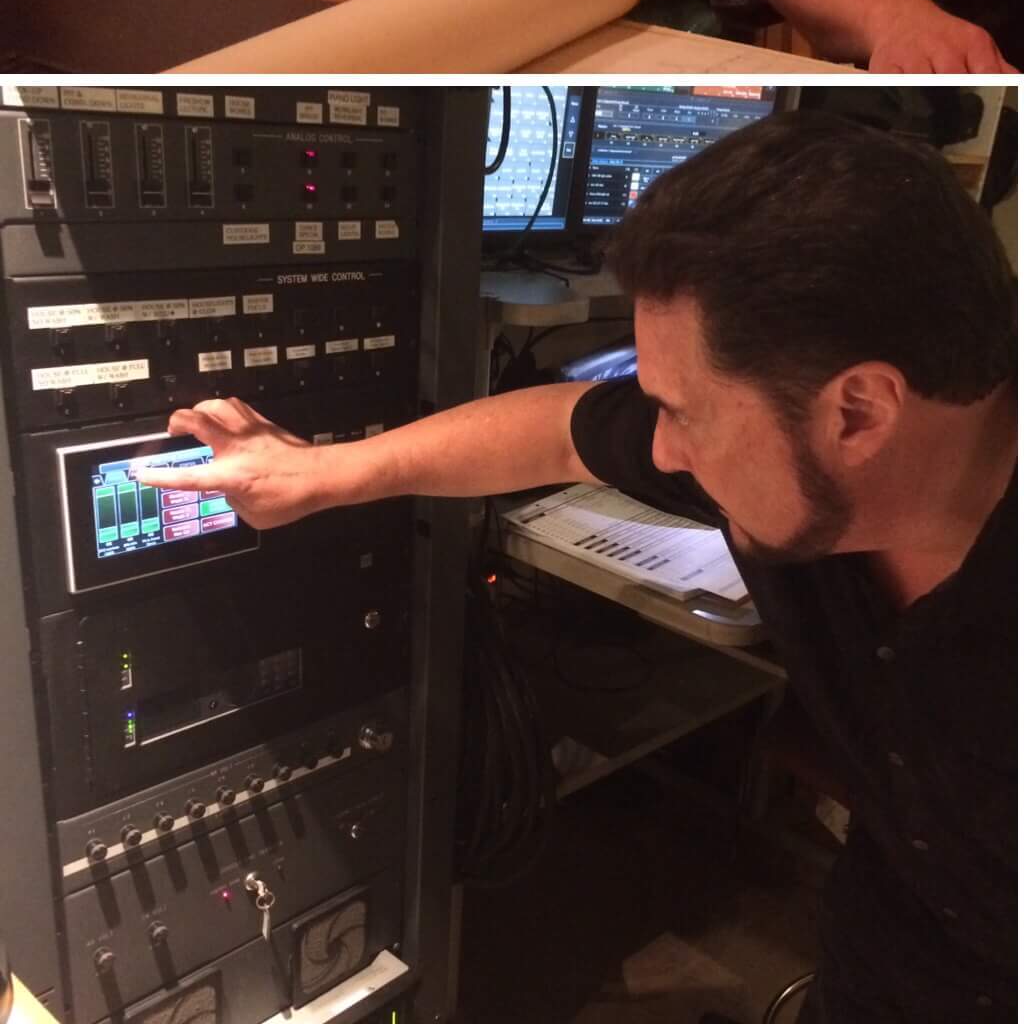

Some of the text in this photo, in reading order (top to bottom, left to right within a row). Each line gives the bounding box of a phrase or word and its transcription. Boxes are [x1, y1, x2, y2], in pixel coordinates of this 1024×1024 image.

[277, 272, 366, 284] SYSTEM WIDE CONTROL
